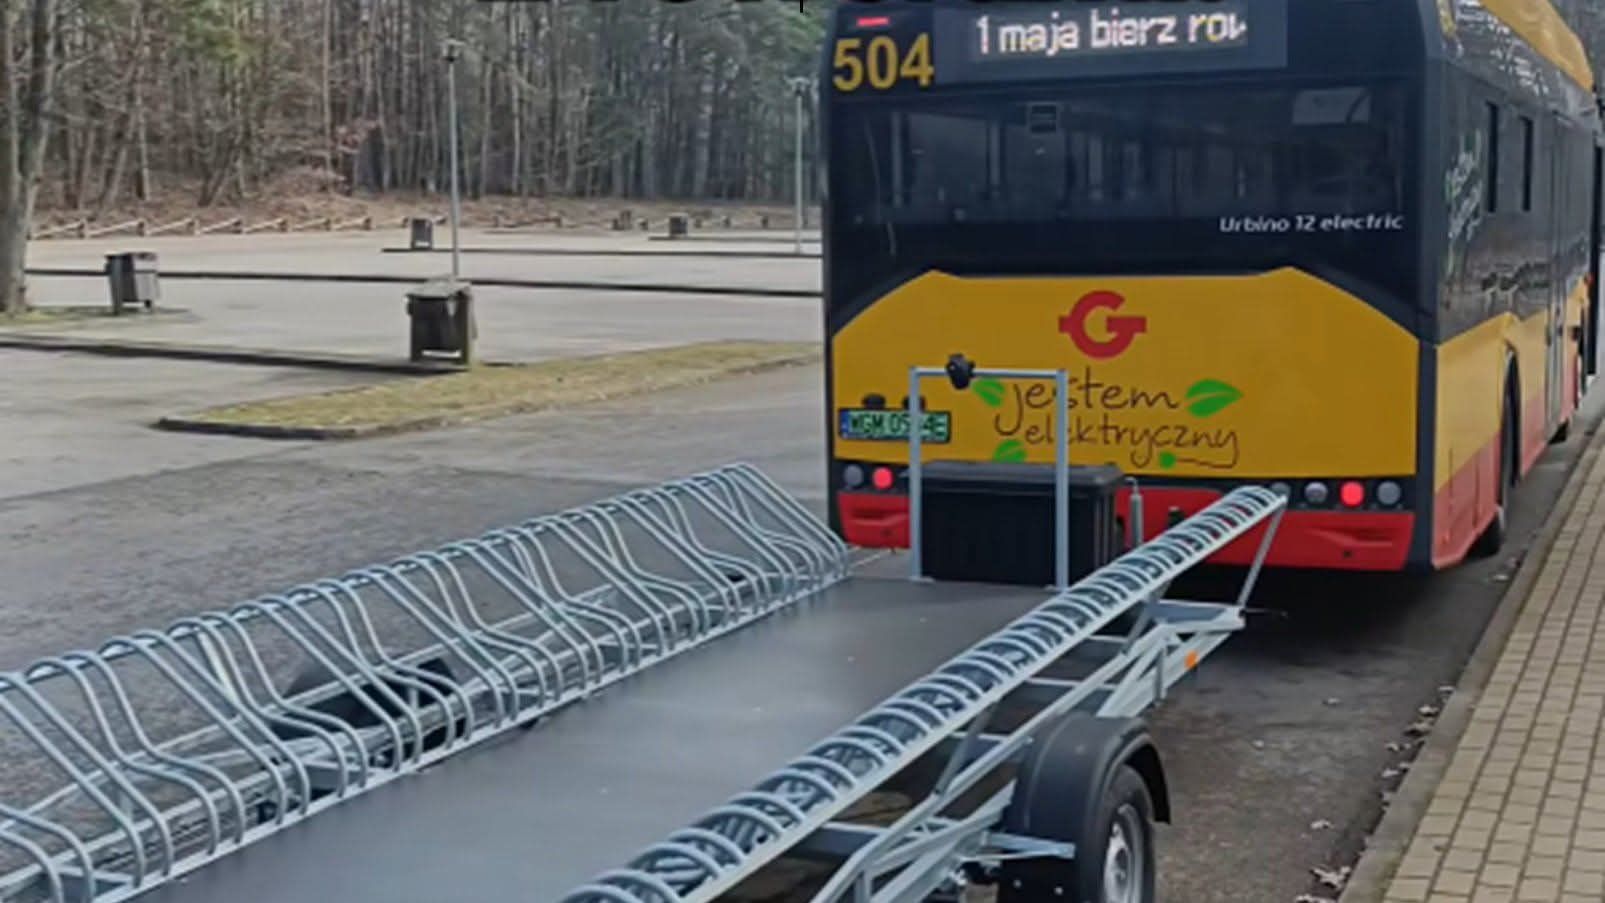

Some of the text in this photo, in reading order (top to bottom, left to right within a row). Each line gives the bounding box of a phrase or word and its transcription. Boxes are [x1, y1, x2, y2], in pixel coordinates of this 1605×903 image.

[977, 15, 990, 53] 1
[1000, 12, 1080, 57] maja
[1090, 10, 1177, 49] bierz
[832, 33, 935, 91] 504
[1219, 212, 1405, 233] Urbino 12 electric
[1024, 413, 1240, 469] elktryczny
